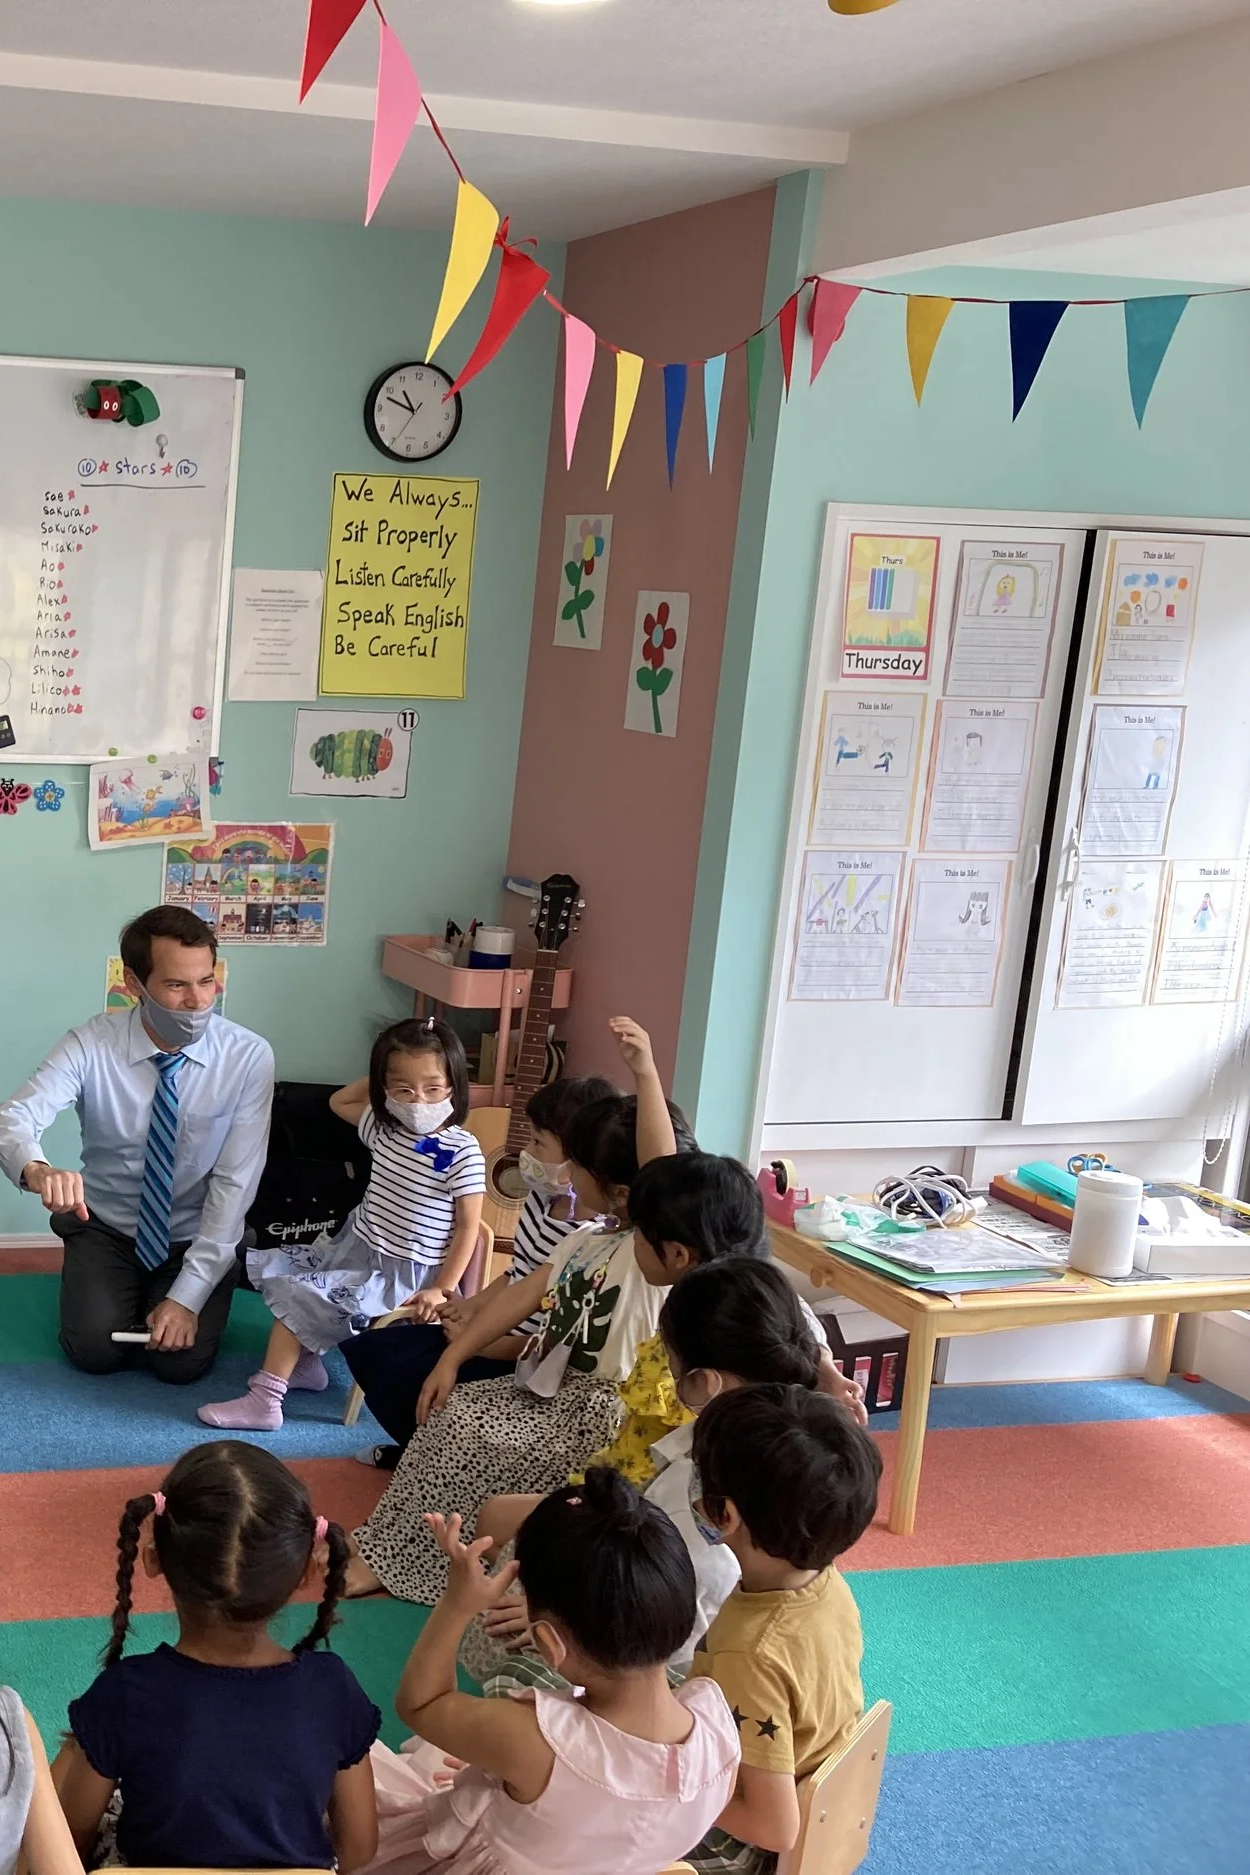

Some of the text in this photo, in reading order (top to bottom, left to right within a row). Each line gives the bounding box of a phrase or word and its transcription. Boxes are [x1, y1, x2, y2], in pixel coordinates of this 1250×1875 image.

[416, 372, 424, 380] 12
[378, 404, 382, 412] 9
[444, 412, 450, 420] 3
[342, 477, 375, 504] We
[42, 505, 82, 518] Sakura
[40, 521, 92, 536] Sakurako
[341, 518, 458, 559] Sit Properly
[41, 540, 75, 553] Misaki
[881, 555, 903, 566] Thurs
[991, 550, 1006, 558] This
[1142, 551, 1156, 559] This
[40, 558, 55, 572] Ao
[39, 576, 56, 590] Rio
[334, 558, 457, 599] Listen Carefully
[37, 594, 61, 606] Alex
[37, 610, 62, 621] Aria
[336, 600, 397, 630] Speak
[404, 602, 465, 634] English
[35, 627, 67, 639] Arisa
[33, 645, 70, 659] Amane
[334, 634, 438, 659] Be Careful
[845, 652, 923, 676] Thursday
[32, 665, 65, 678] Shiho
[31, 682, 63, 696] Lilico
[30, 701, 67, 715] Hinano
[857, 702, 873, 710] This
[969, 708, 985, 717] This
[400, 710, 416, 728] 11
[1124, 715, 1137, 724] This
[837, 861, 853, 870] This
[944, 869, 959, 877] This
[265, 1218, 336, 1241] Epiphone
